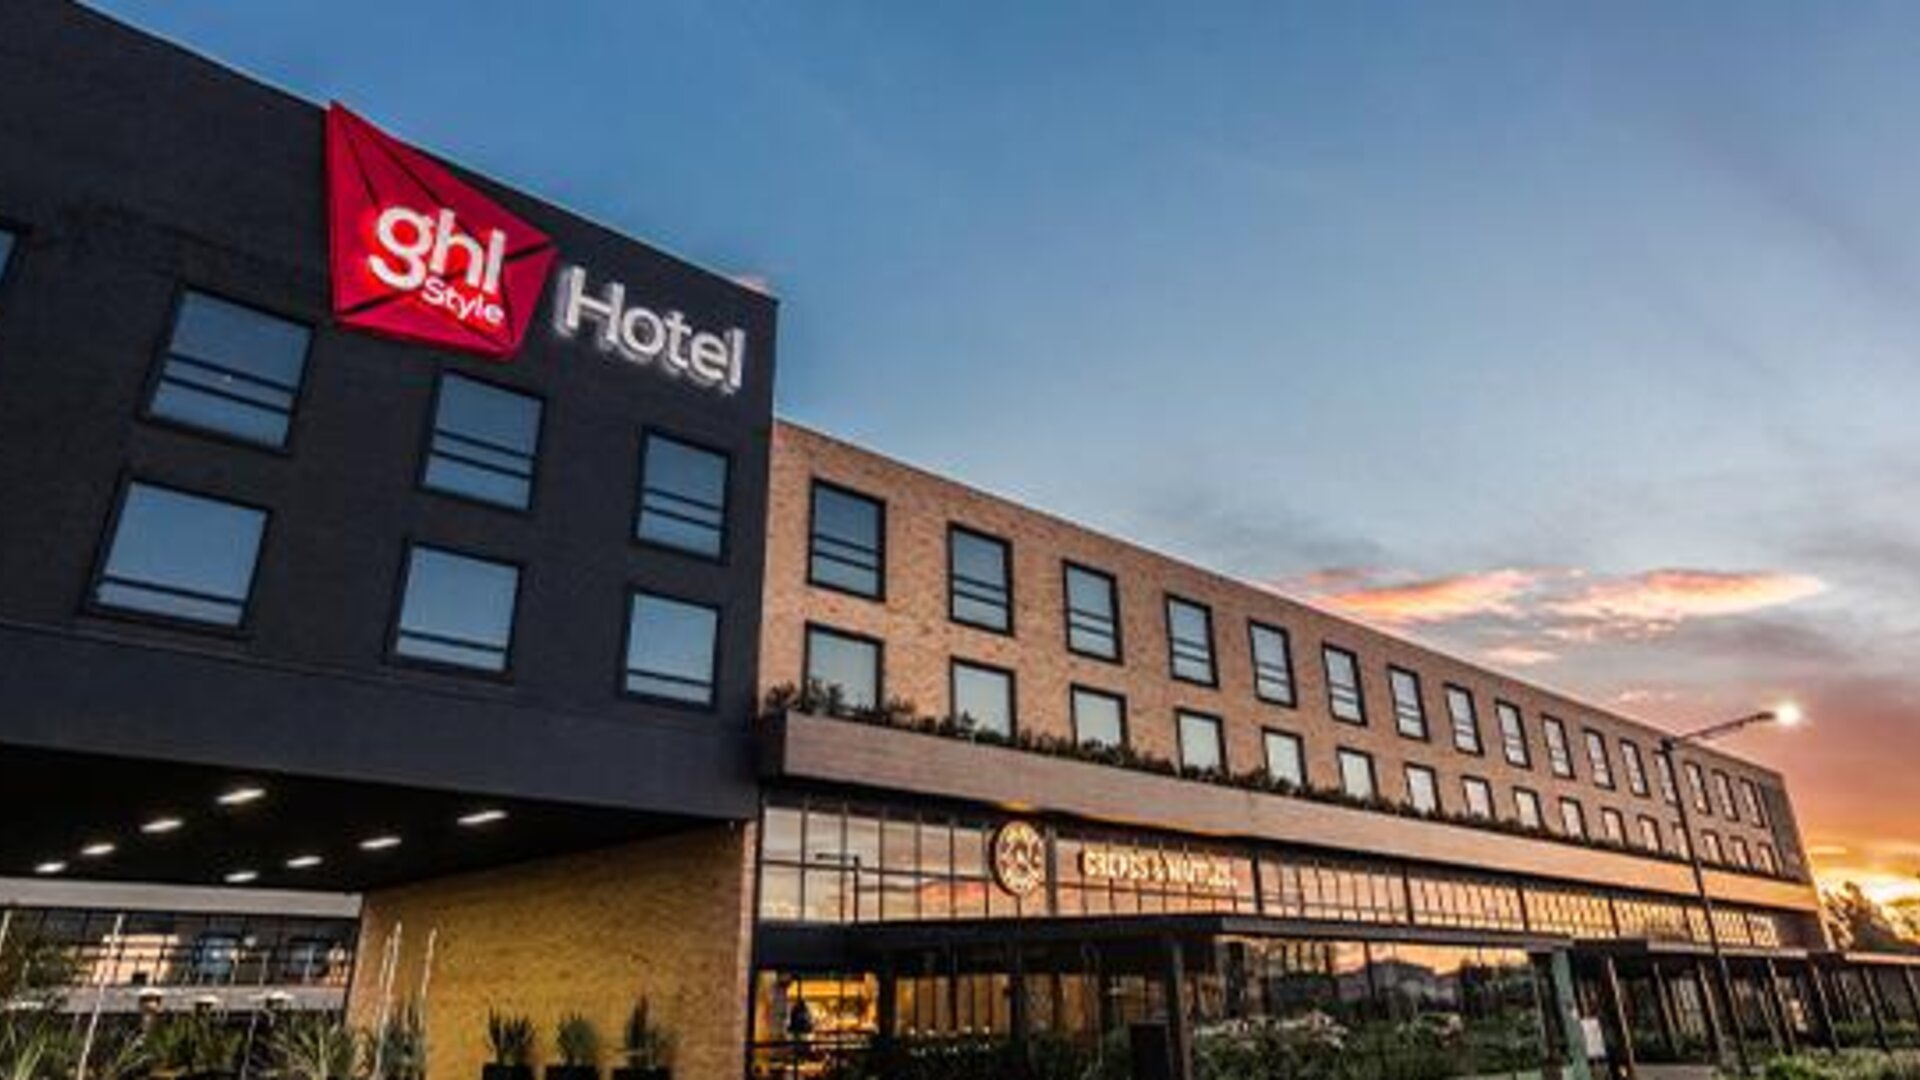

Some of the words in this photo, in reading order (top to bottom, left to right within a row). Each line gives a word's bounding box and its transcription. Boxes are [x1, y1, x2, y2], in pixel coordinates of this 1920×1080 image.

[368, 205, 506, 294] ghl
[421, 275, 505, 326] Style
[553, 265, 747, 393] Hotel
